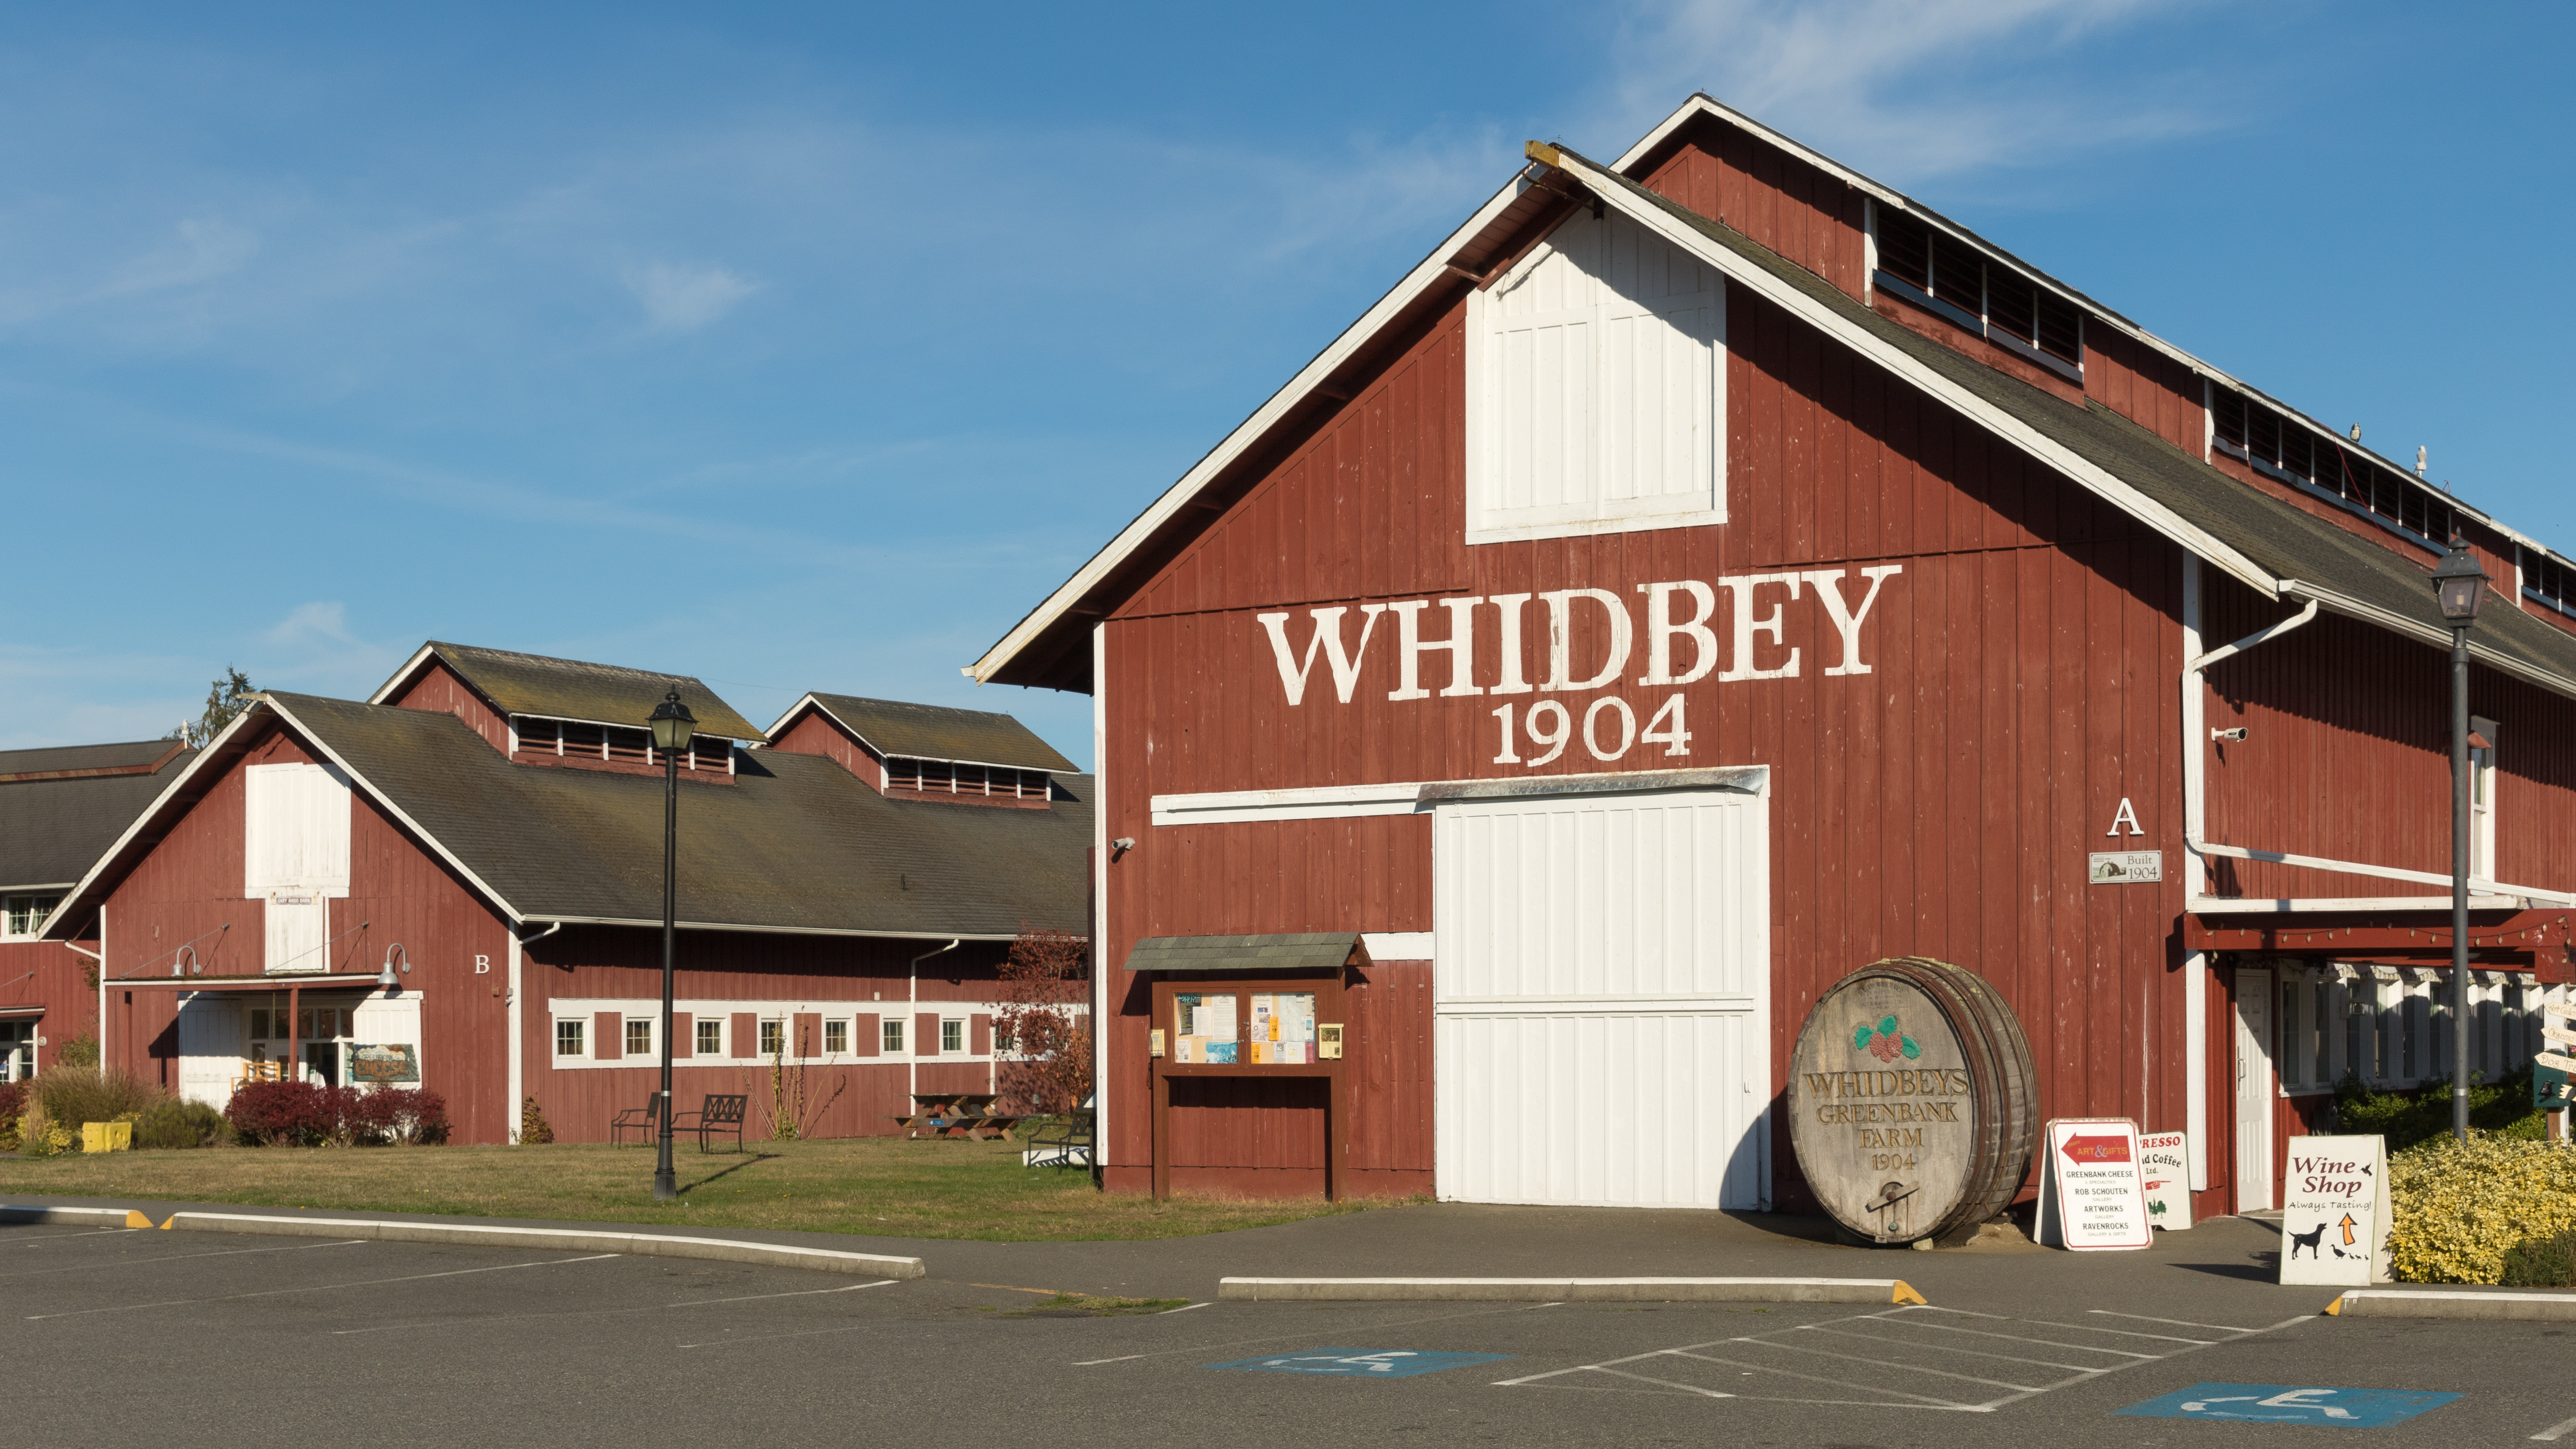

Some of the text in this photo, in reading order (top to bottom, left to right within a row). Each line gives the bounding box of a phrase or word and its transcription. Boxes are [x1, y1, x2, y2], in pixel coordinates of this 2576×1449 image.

[1257, 564, 1902, 706] WHIDBEY
[1492, 693, 1692, 766] 1904
[2107, 797, 2144, 836] A
[2127, 854, 2152, 865] Built
[2129, 866, 2157, 879] 1904
[475, 955, 490, 974] B
[2548, 1028, 2574, 1042] Organic
[355, 1060, 409, 1077] CHEESE
[2542, 1055, 2560, 1068] Dog
[1803, 1068, 1969, 1099] WHIDBEYS
[1816, 1102, 1958, 1126] GREENBANK
[1860, 1127, 1924, 1149] FARM
[2068, 1139, 2081, 1148] more
[2140, 1136, 2181, 1149] RESSO
[2077, 1144, 2128, 1158] ART & GIFTS
[1872, 1153, 1916, 1171] 1904
[2152, 1154, 2182, 1167] Coffee
[2292, 1157, 2356, 1174] Wine
[2302, 1175, 2362, 1199] Shop
[2288, 1199, 2372, 1213] Always Tasting!
